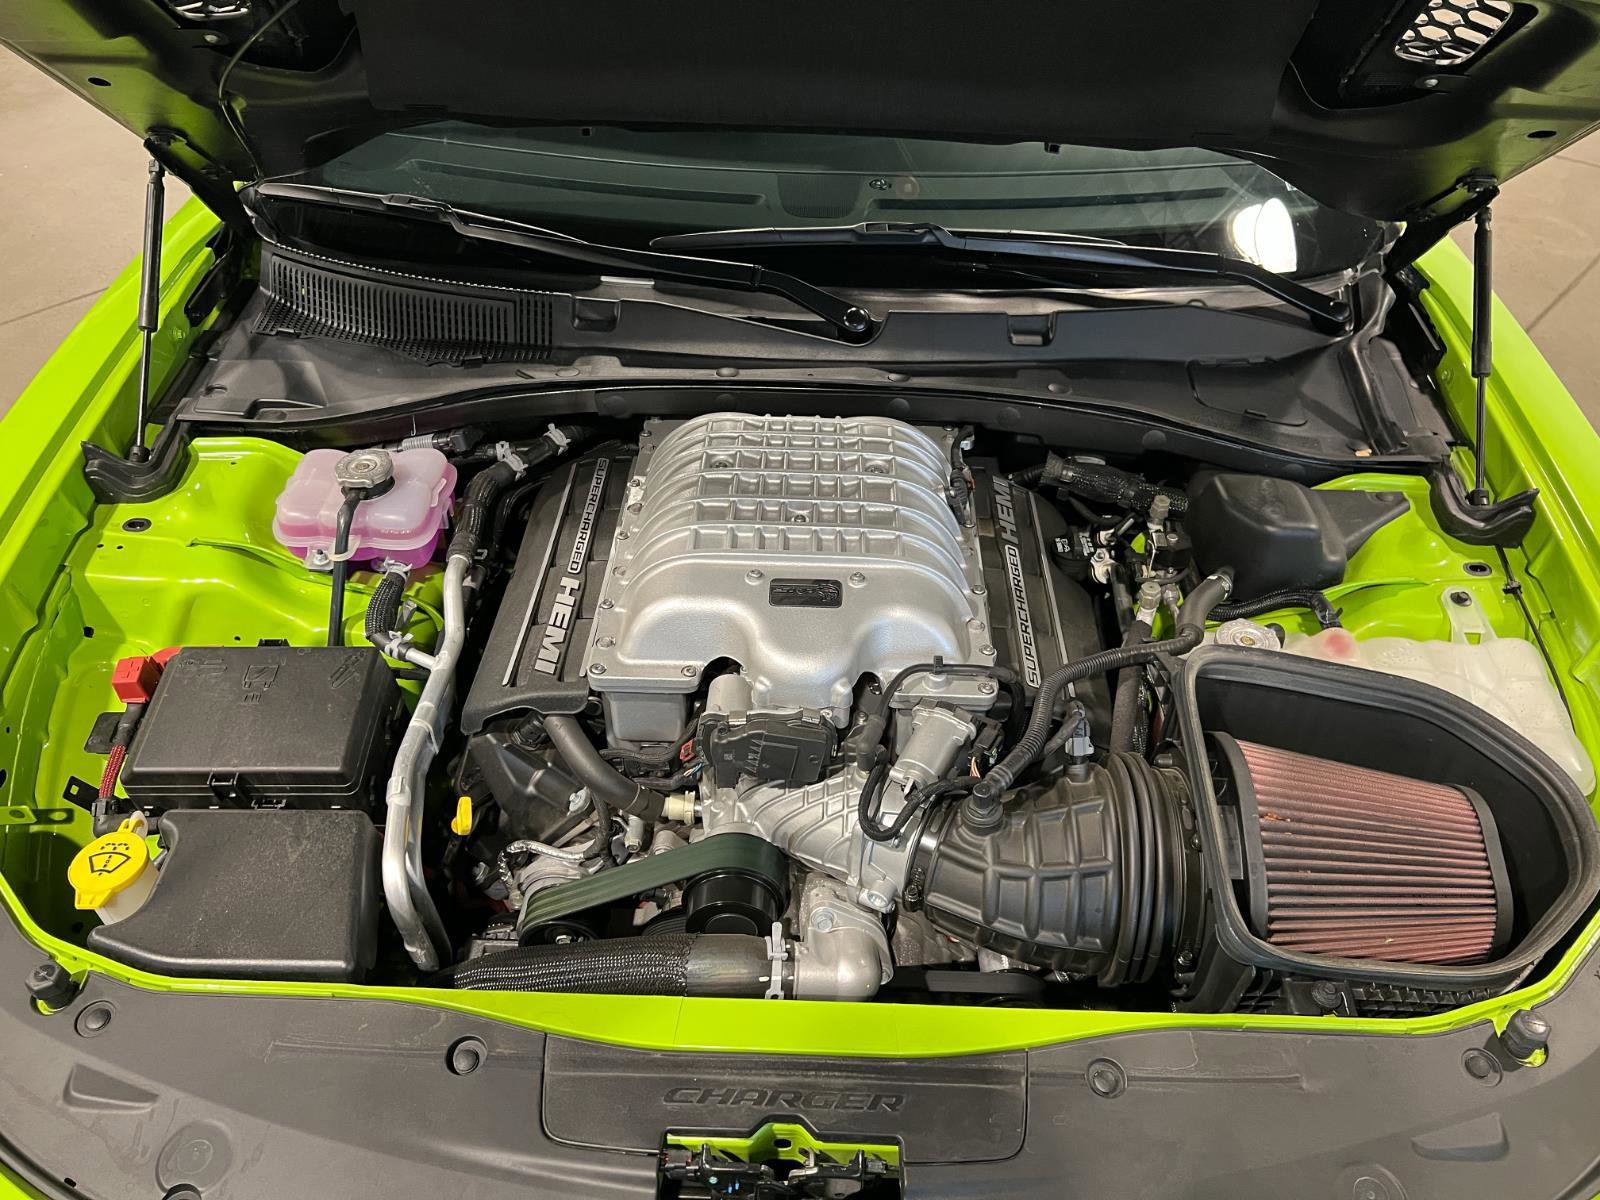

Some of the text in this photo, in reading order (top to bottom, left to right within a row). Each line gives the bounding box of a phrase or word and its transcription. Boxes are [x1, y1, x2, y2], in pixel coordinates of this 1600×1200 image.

[535, 459, 608, 674] SUPERCHARGED HEMI
[993, 476, 1041, 687] SUPERCHARGED HEMI
[663, 1087, 903, 1112] CHARGER
